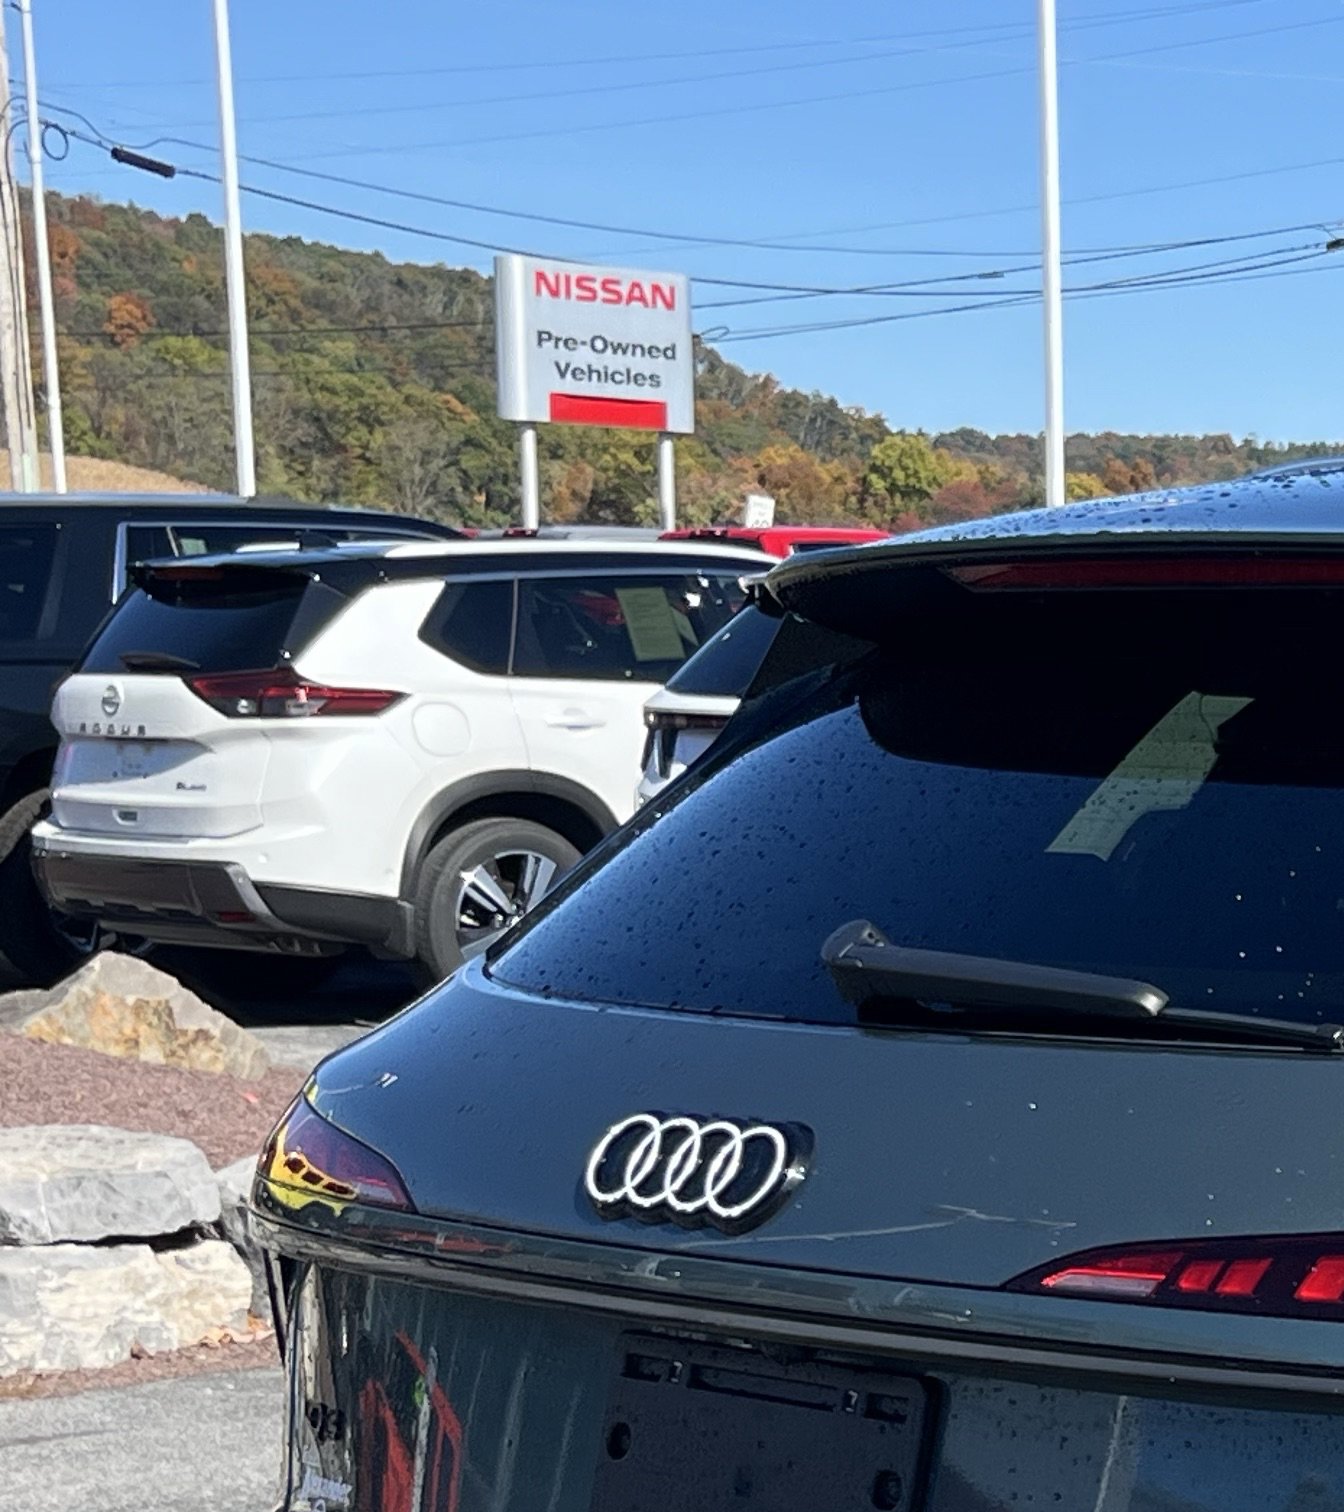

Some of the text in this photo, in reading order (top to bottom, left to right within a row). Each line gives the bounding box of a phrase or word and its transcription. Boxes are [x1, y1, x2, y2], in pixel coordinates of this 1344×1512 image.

[534, 269, 676, 312] NISSAN
[536, 329, 677, 361] Pre-Owned
[554, 360, 662, 389] Vehicles
